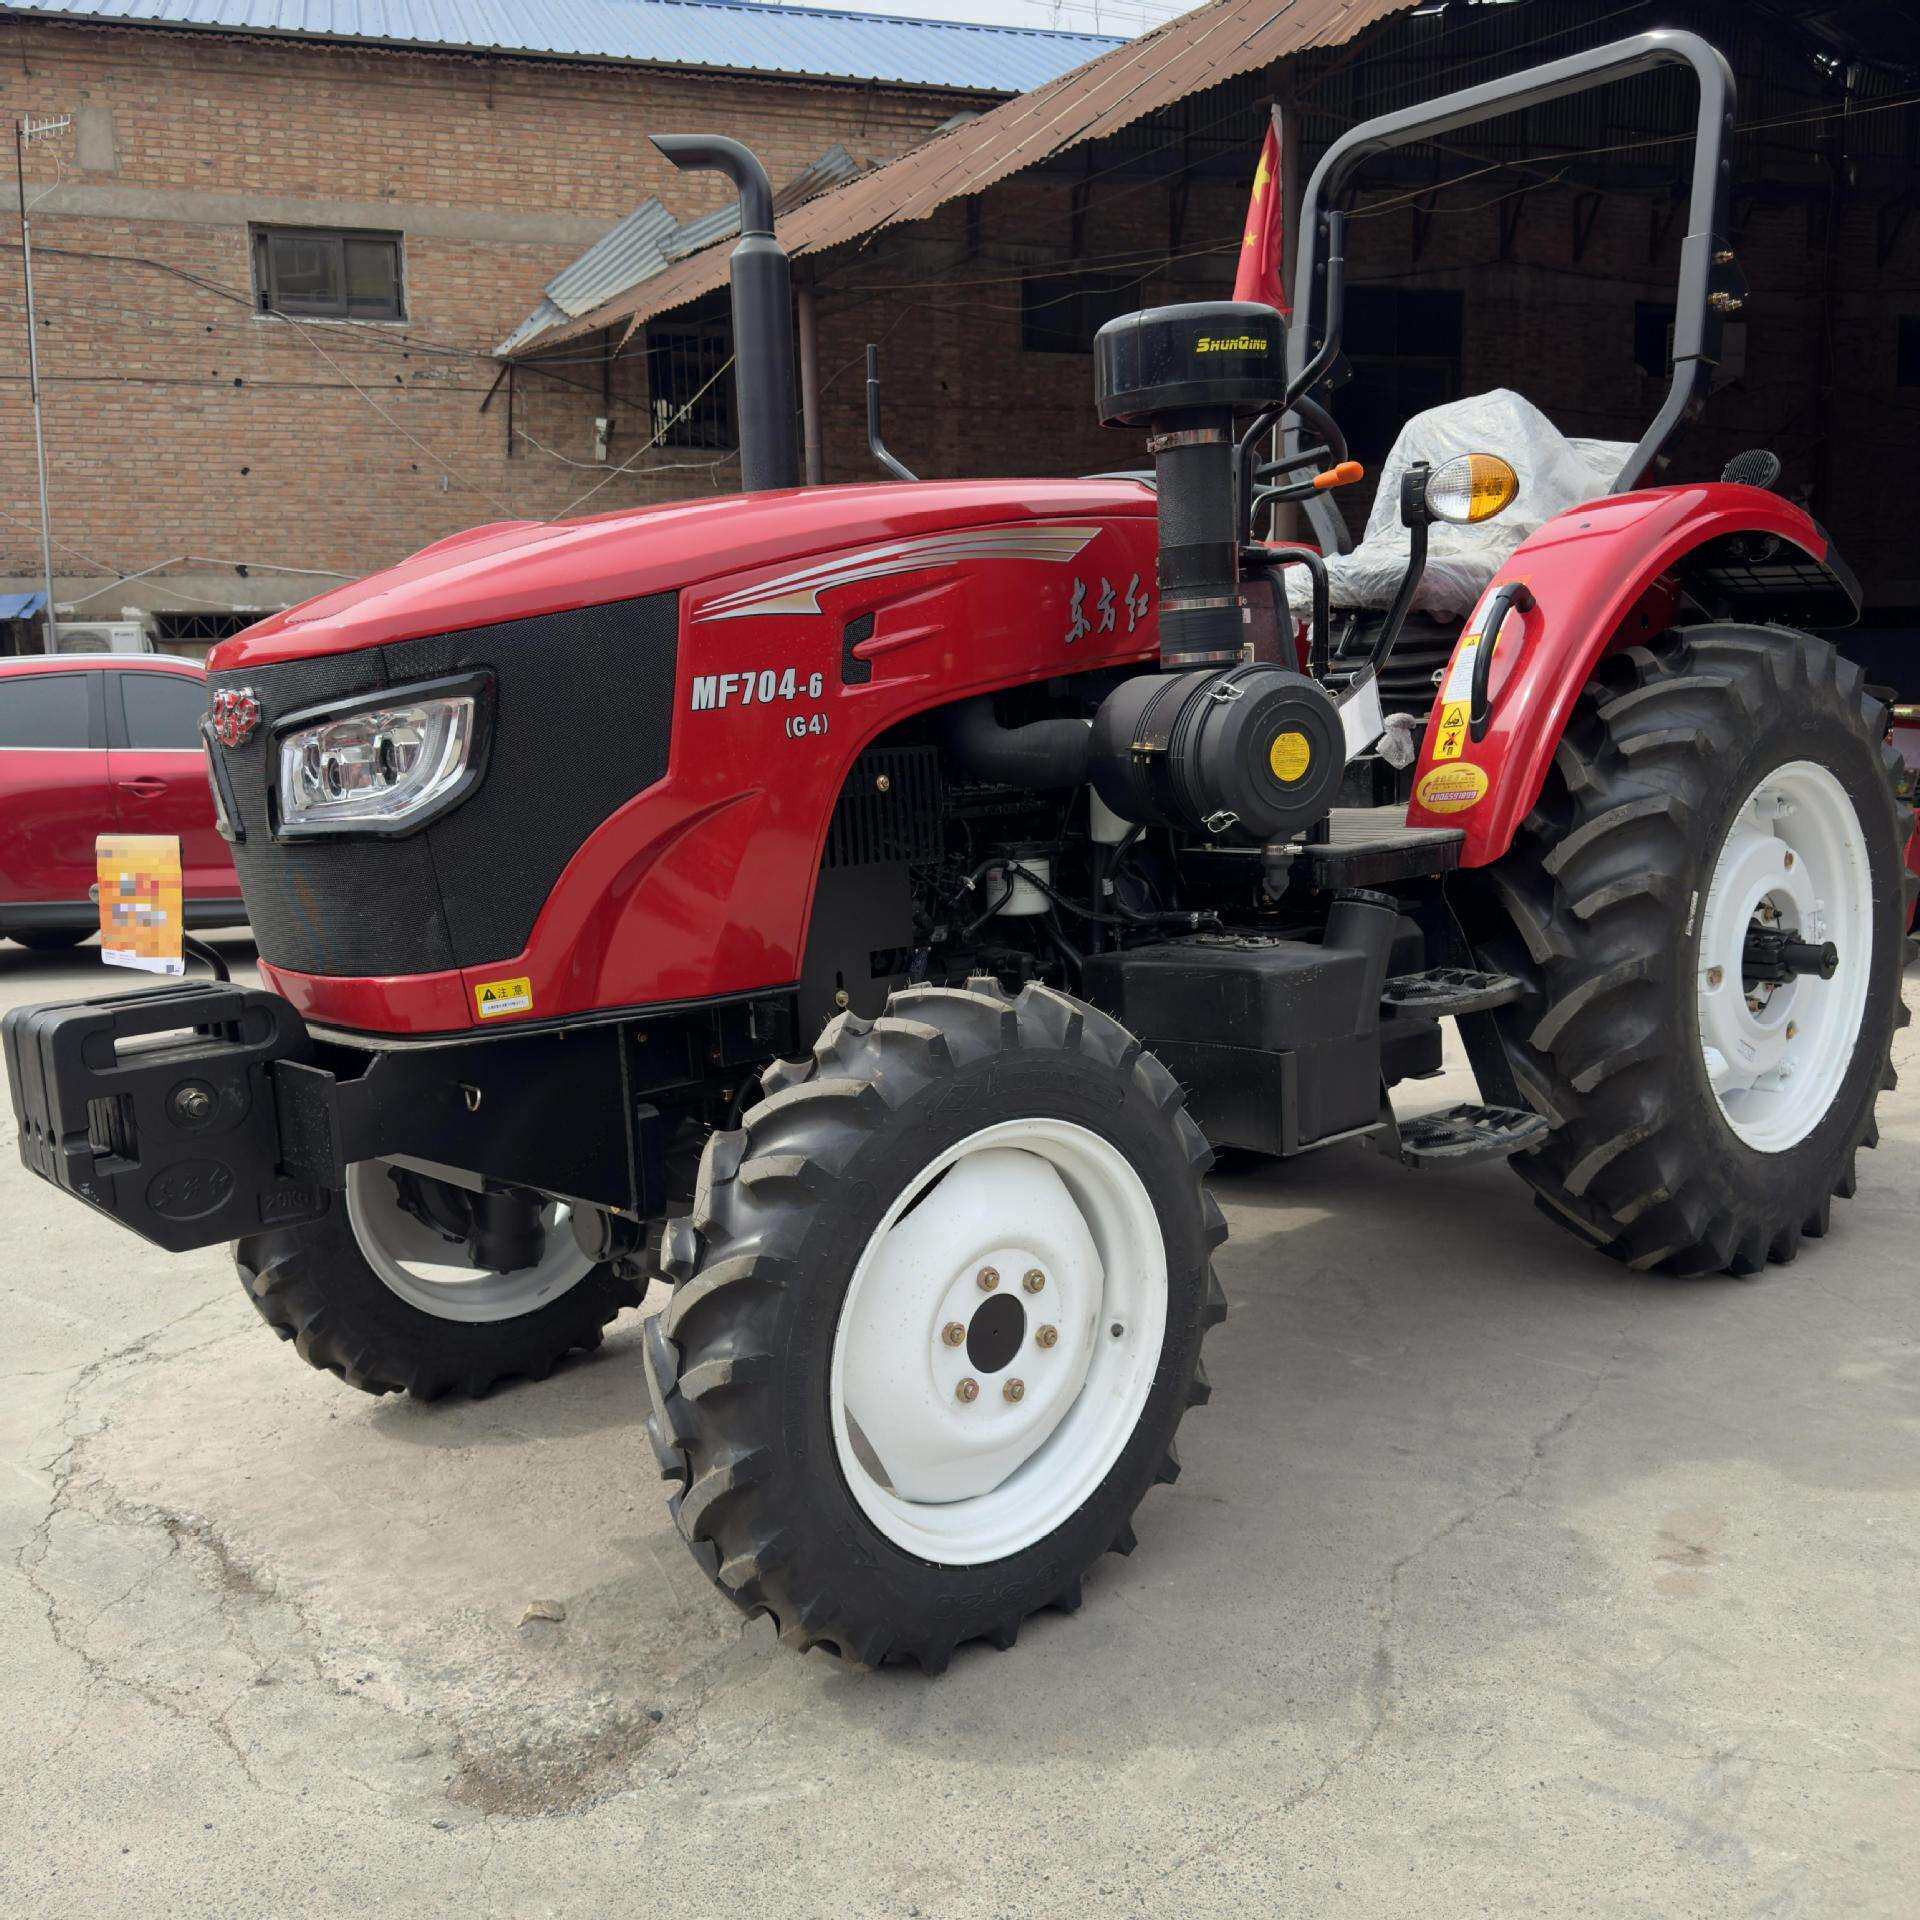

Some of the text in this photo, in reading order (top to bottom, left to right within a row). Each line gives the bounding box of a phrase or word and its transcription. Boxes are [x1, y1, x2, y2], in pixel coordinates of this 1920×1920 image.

[1065, 573, 1149, 643] 东方红
[690, 667, 823, 711] MF704-6
[785, 713, 828, 738] (G4)
[497, 984, 524, 999] 注意
